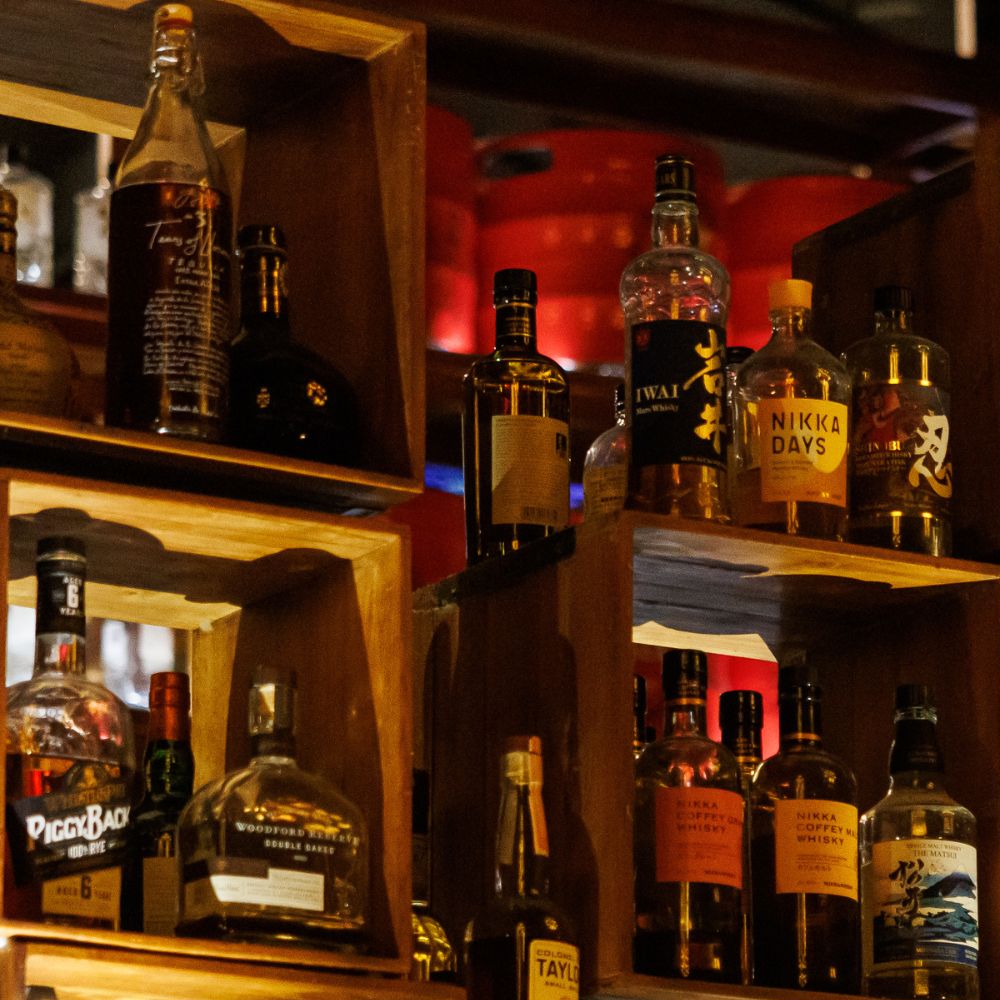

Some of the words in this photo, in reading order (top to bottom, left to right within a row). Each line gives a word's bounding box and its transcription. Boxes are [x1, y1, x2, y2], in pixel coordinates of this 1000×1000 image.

[634, 384, 679, 403] IWAI
[652, 403, 679, 414] Whisky
[772, 411, 841, 435] NIKKA
[772, 436, 826, 455] DAYS
[66, 584, 79, 609] 6
[676, 800, 719, 810] NIKKA
[796, 812, 838, 822] NIKKA
[234, 821, 306, 838] WOODFORD
[676, 823, 727, 835] WHISKY
[796, 823, 844, 834] COFFEY
[88, 840, 107, 856] RYE
[796, 835, 845, 847] WHISKY
[913, 850, 928, 858] THE
[929, 850, 957, 859] MATSUI
[80, 873, 92, 900] 6
